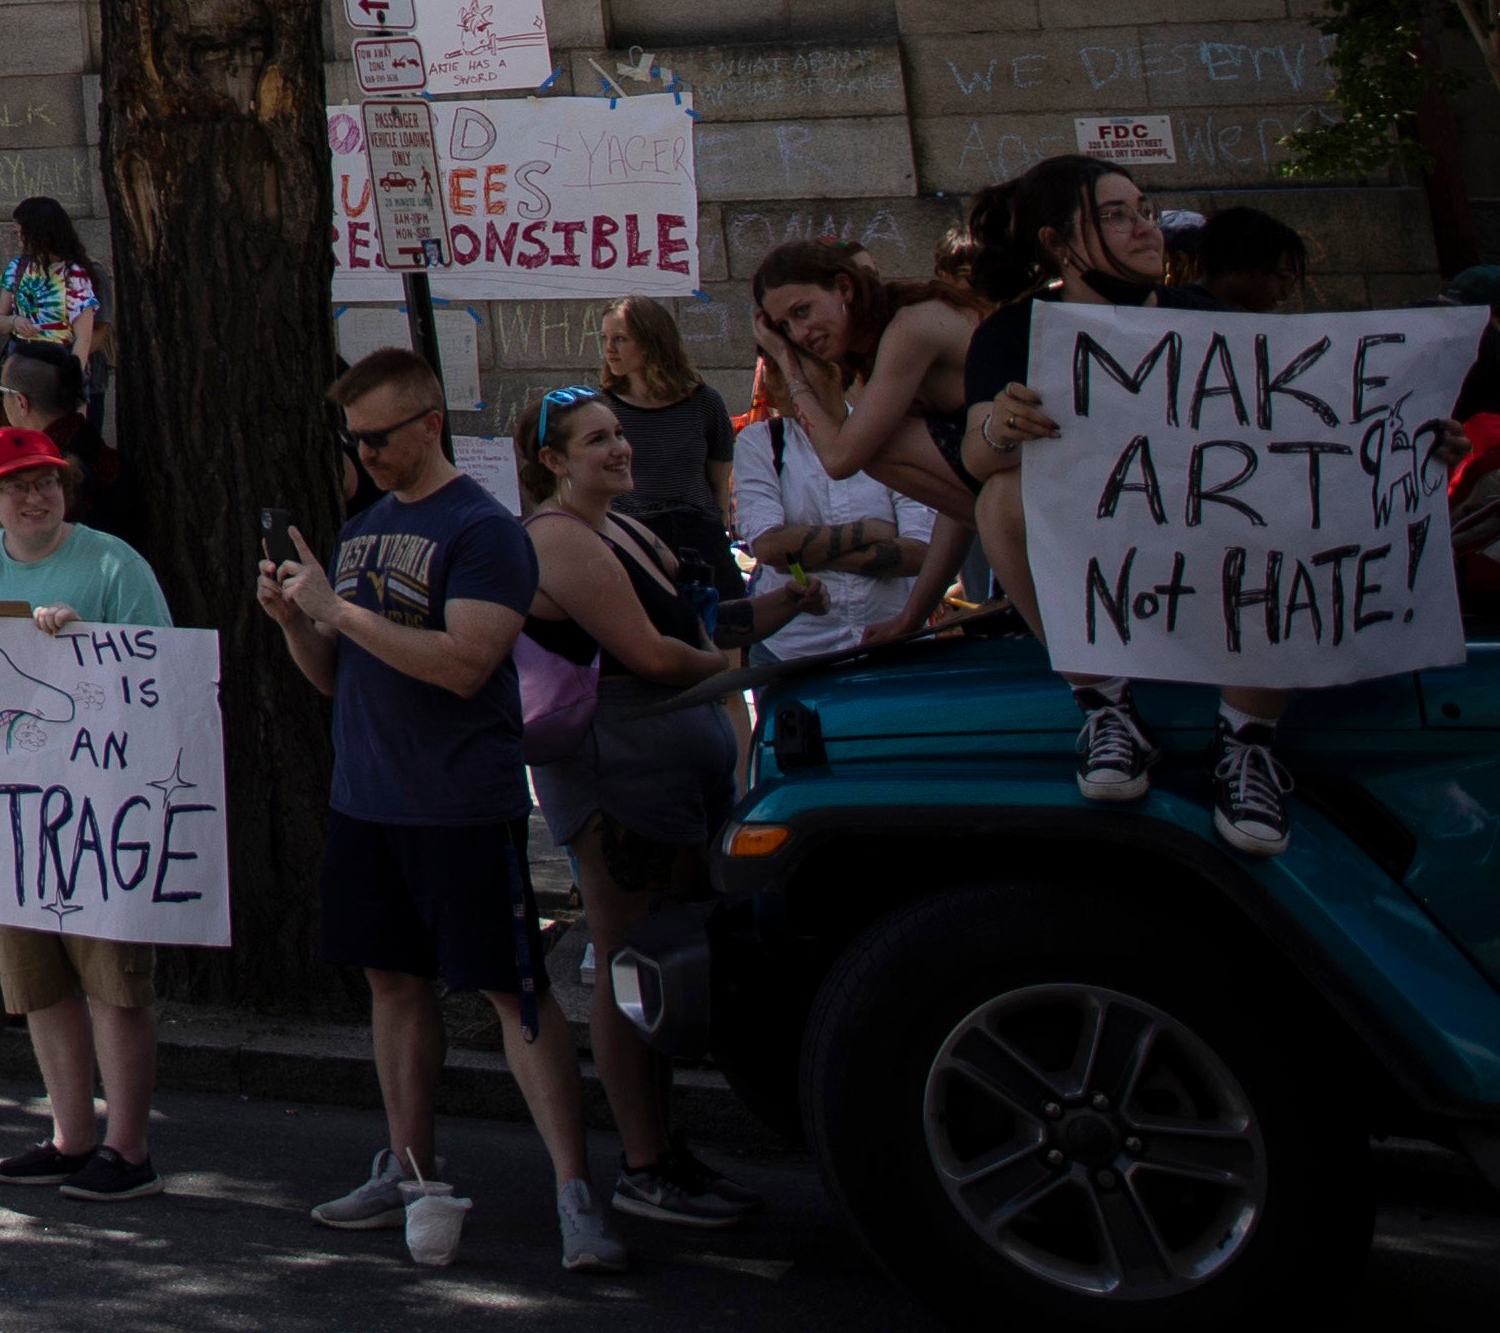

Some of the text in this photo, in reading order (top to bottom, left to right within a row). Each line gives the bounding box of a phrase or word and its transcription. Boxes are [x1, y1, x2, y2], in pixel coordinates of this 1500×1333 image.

[357, 48, 392, 60] TOW AWAY
[368, 61, 386, 72] ZONE
[428, 59, 508, 76] ARTIE HAS A
[453, 72, 498, 88] SWORD
[374, 113, 420, 129] PASSENGER
[370, 132, 431, 148] VEHICLE LOADING
[1097, 123, 1149, 140] FDC
[391, 150, 411, 166] ONLY
[577, 130, 695, 191] YAGER
[1071, 330, 1407, 432] MAKE
[1096, 434, 1354, 530] ART
[1085, 514, 1432, 653] Not HATE!
[54, 629, 159, 667] THIS
[121, 674, 160, 708] IS
[69, 726, 129, 770] AN
